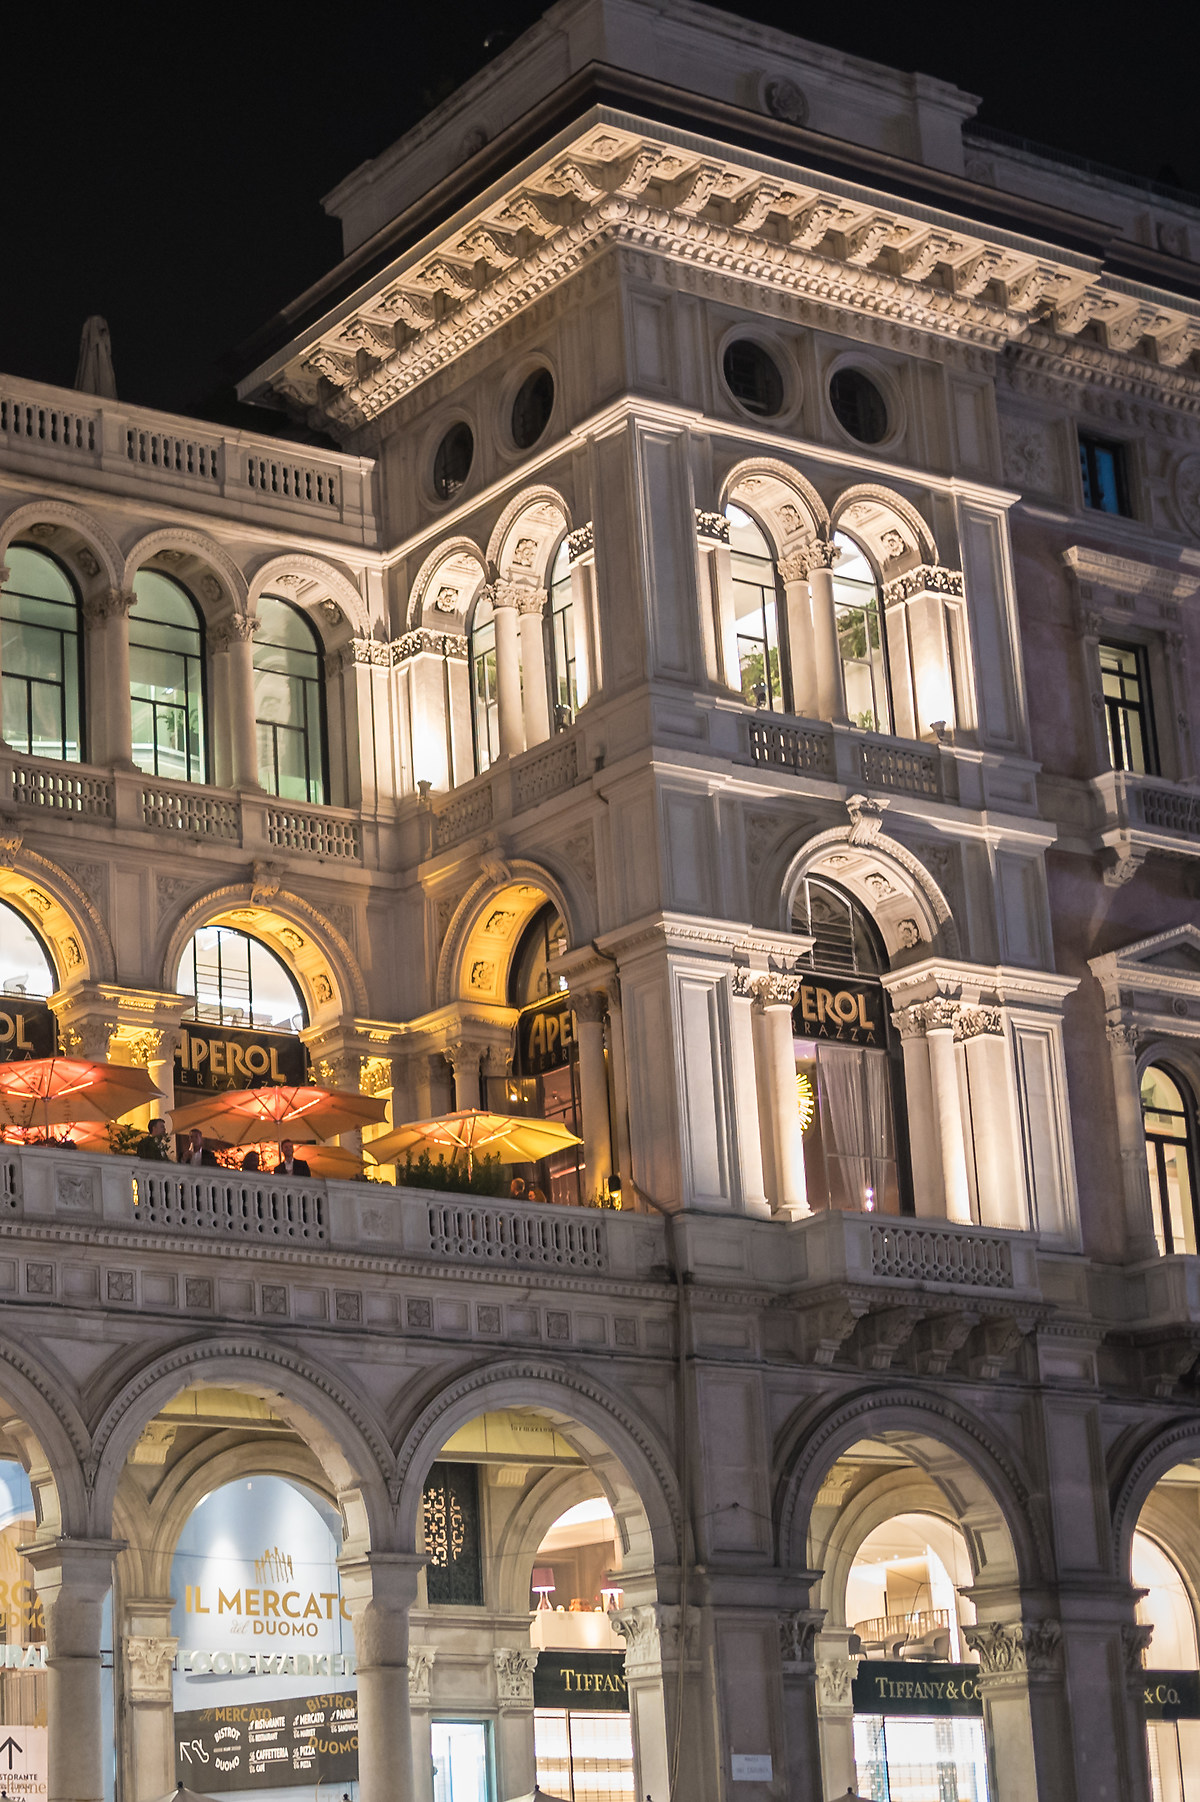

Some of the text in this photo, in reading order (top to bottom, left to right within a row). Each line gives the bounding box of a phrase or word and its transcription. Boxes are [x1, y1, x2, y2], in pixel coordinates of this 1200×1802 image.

[185, 1585, 210, 1613] IL
[253, 1620, 318, 1637] DUOMO
[176, 1650, 356, 1677] FOOD MARKET
[875, 1677, 944, 1699] TIFFANY
[215, 1707, 272, 1722] MERCATO
[254, 1715, 286, 1730] RISTORANTE
[299, 1711, 325, 1726] MERCATO
[214, 1726, 241, 1743] BISTROT
[256, 1747, 289, 1760] CAFFETTERIA
[300, 1743, 316, 1757] PIZZA
[215, 1755, 240, 1772] DUOMO
